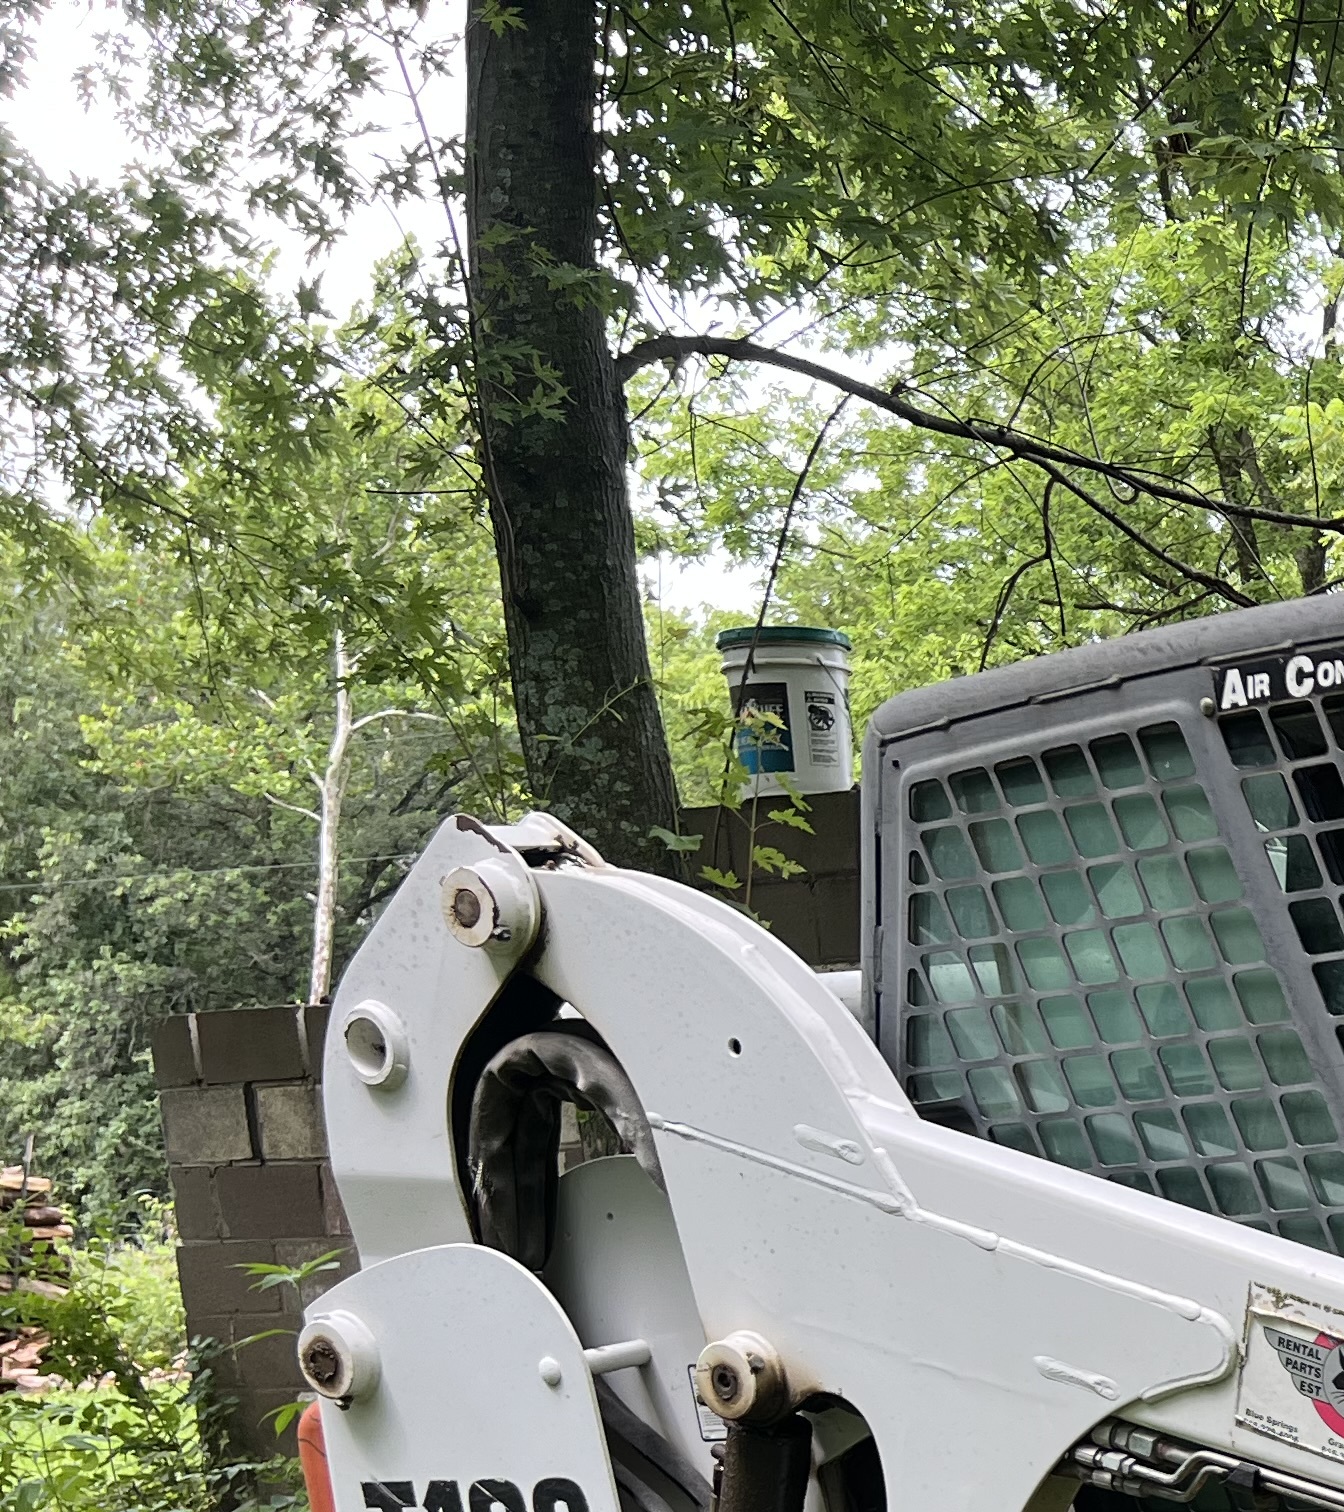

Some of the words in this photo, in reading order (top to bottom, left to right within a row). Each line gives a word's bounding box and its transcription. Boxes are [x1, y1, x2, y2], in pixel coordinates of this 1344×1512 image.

[1221, 667, 1271, 710] AIR
[1277, 1336, 1321, 1361] RENTAL
[1285, 1357, 1321, 1379] PARTS
[1245, 1407, 1264, 1421] Blue
[1266, 1415, 1298, 1433] Springs
